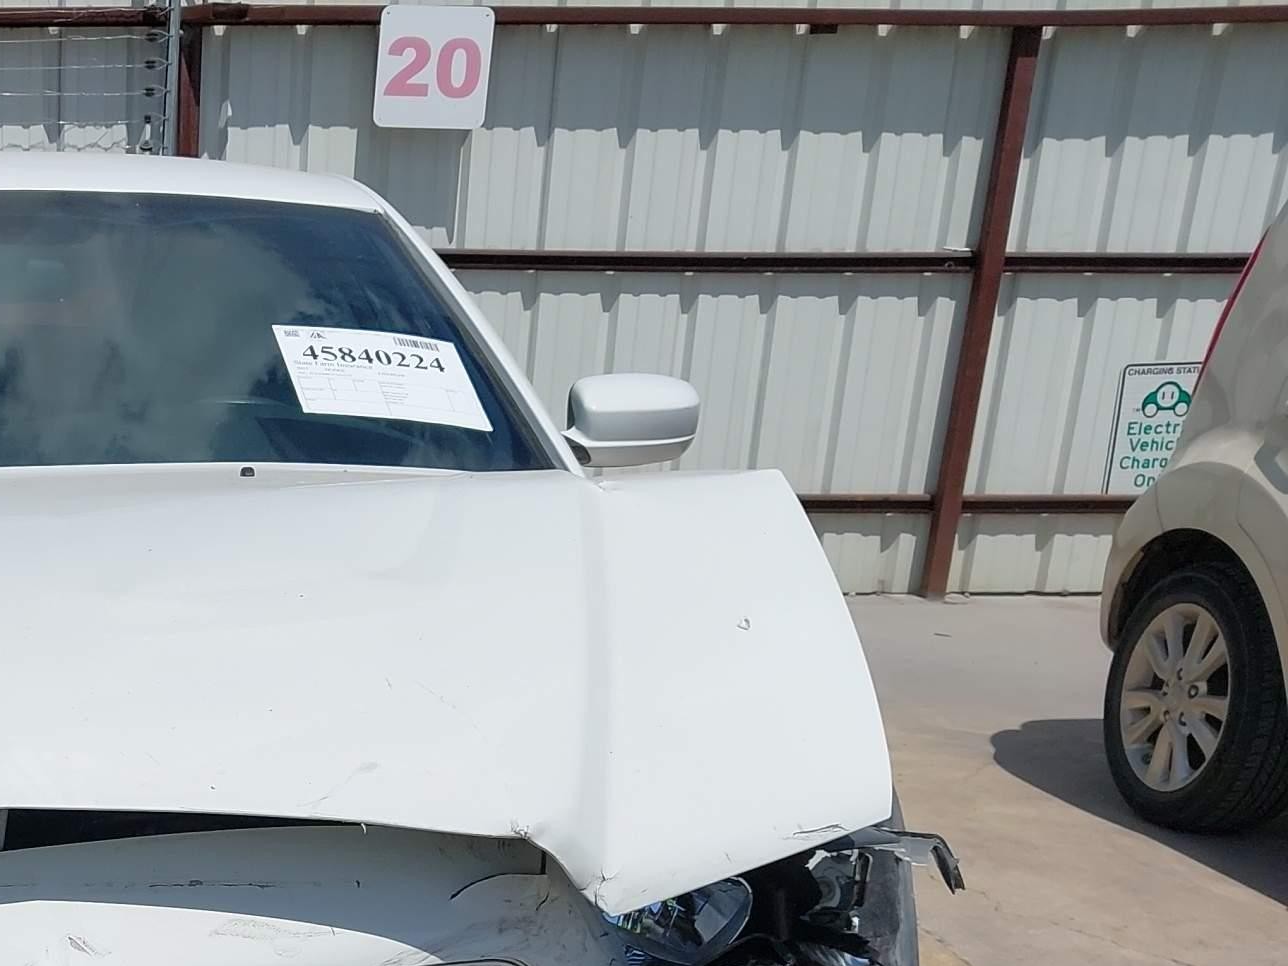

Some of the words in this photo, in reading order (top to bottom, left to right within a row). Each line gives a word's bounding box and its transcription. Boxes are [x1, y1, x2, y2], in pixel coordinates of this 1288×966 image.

[383, 36, 482, 99] 20
[302, 344, 445, 373] 45840224
[1127, 367, 1174, 376] CHARGING
[1127, 420, 1181, 436] Electr
[1129, 437, 1175, 452] Vehic
[1134, 473, 1156, 488] On
